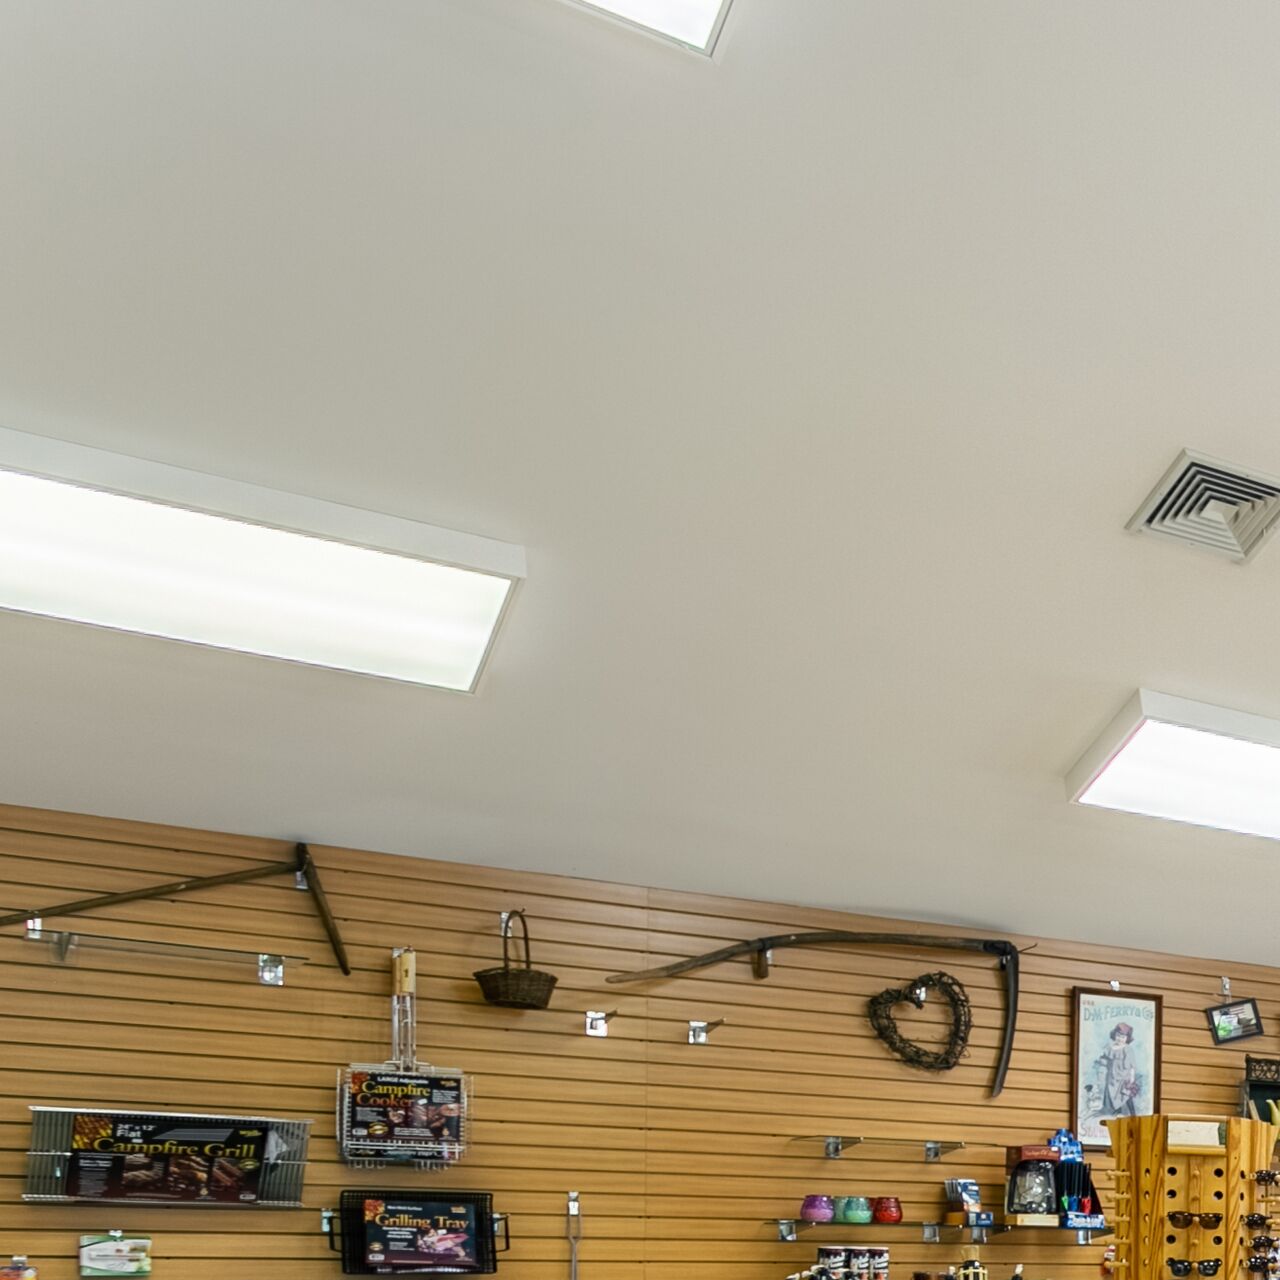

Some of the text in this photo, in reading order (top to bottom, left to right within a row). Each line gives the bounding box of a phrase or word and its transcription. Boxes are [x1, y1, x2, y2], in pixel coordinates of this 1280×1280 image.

[361, 1081, 431, 1097] Campfire
[356, 1093, 413, 1107] Cooker
[116, 1129, 142, 1138] Flat
[94, 1138, 255, 1158] Campfire Grill
[375, 1213, 469, 1229] Grilling Tray
